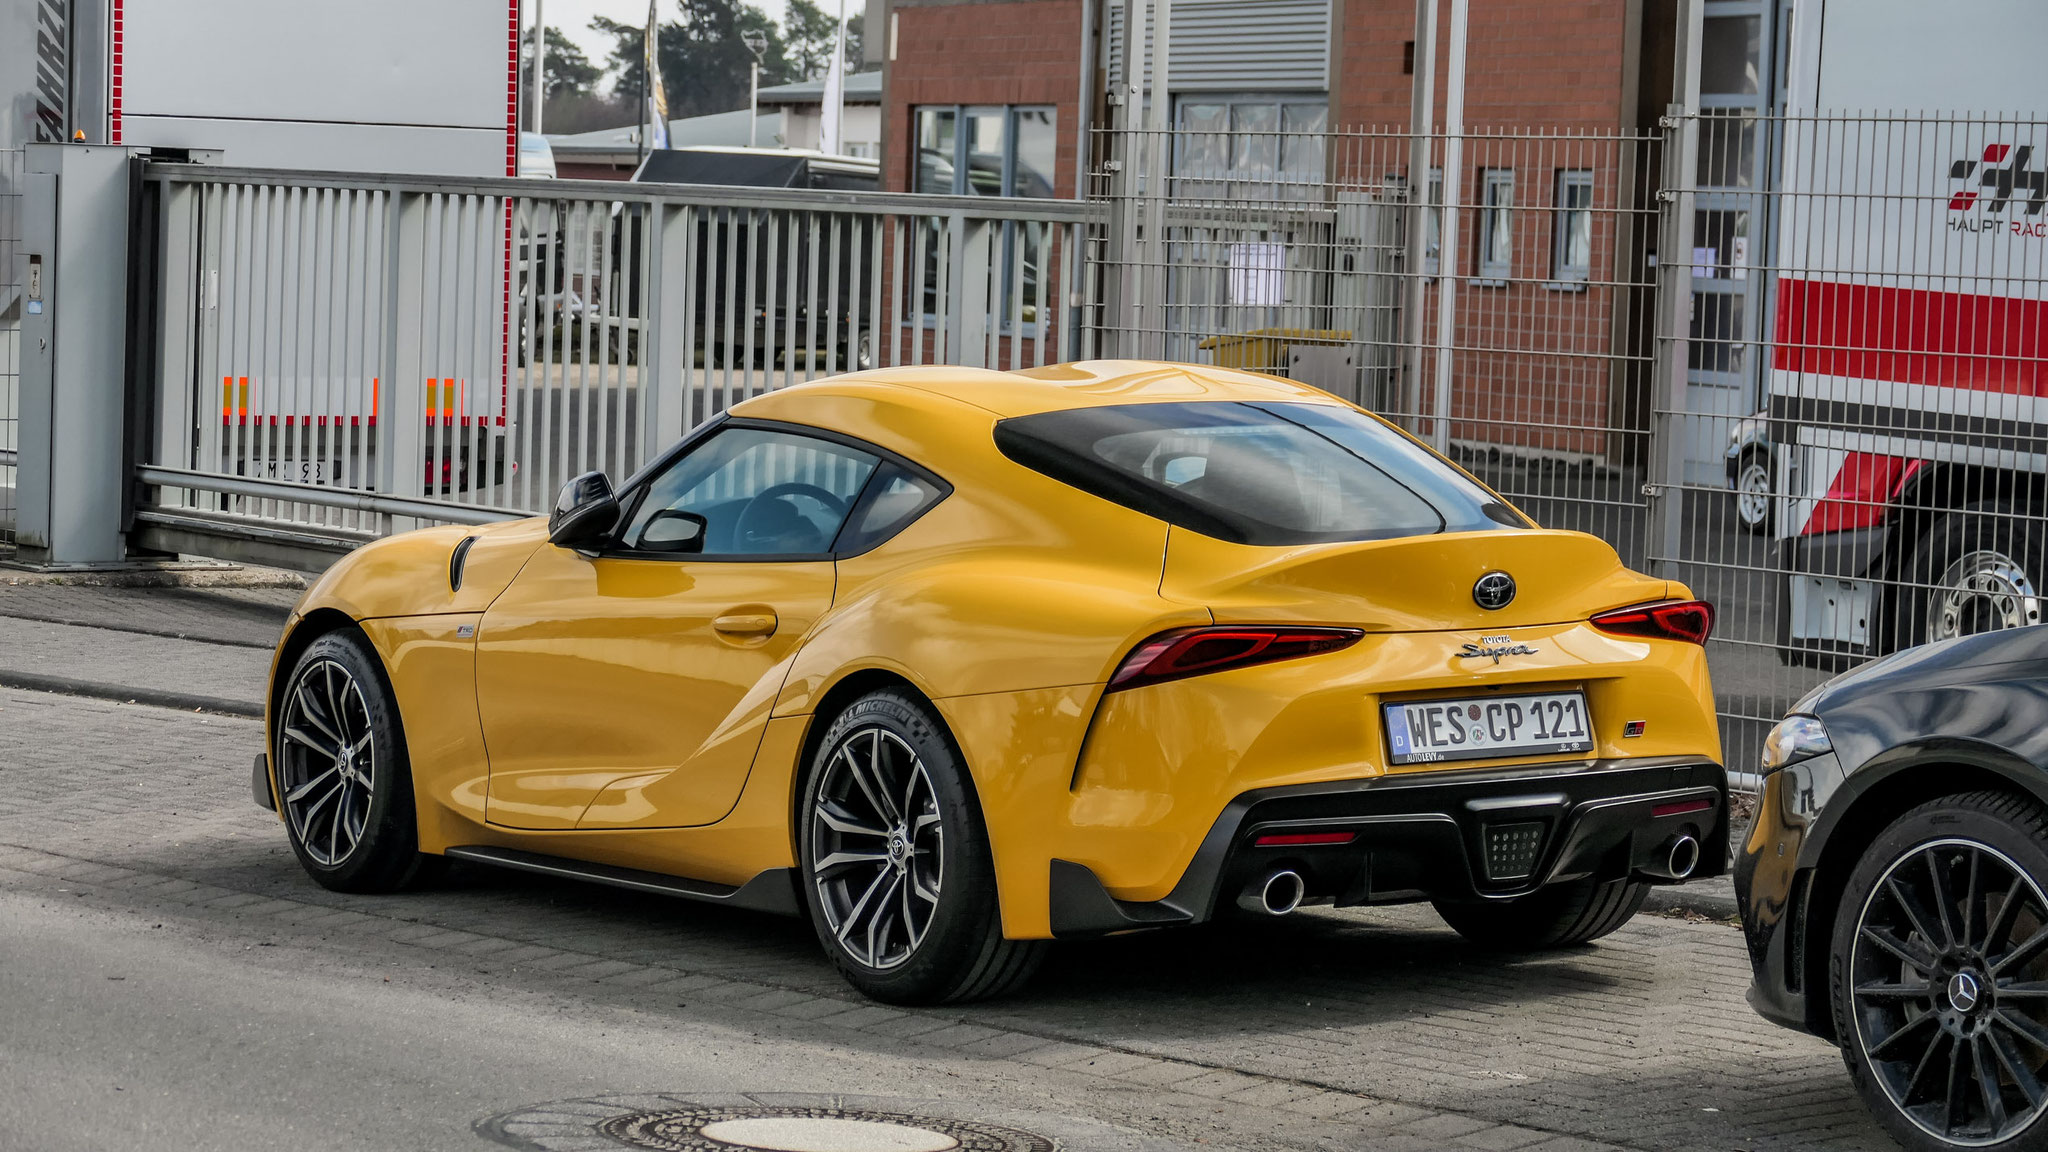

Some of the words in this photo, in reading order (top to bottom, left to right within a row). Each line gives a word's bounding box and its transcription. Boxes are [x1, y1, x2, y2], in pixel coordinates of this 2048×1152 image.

[1482, 635, 1512, 644] TOYOTA
[1455, 644, 1539, 664] Supra
[856, 701, 910, 724] MICHELIN
[1407, 707, 1466, 747] WES
[1486, 702, 1523, 742] CP
[1530, 698, 1585, 739] 121
[1396, 736, 1404, 747] D
